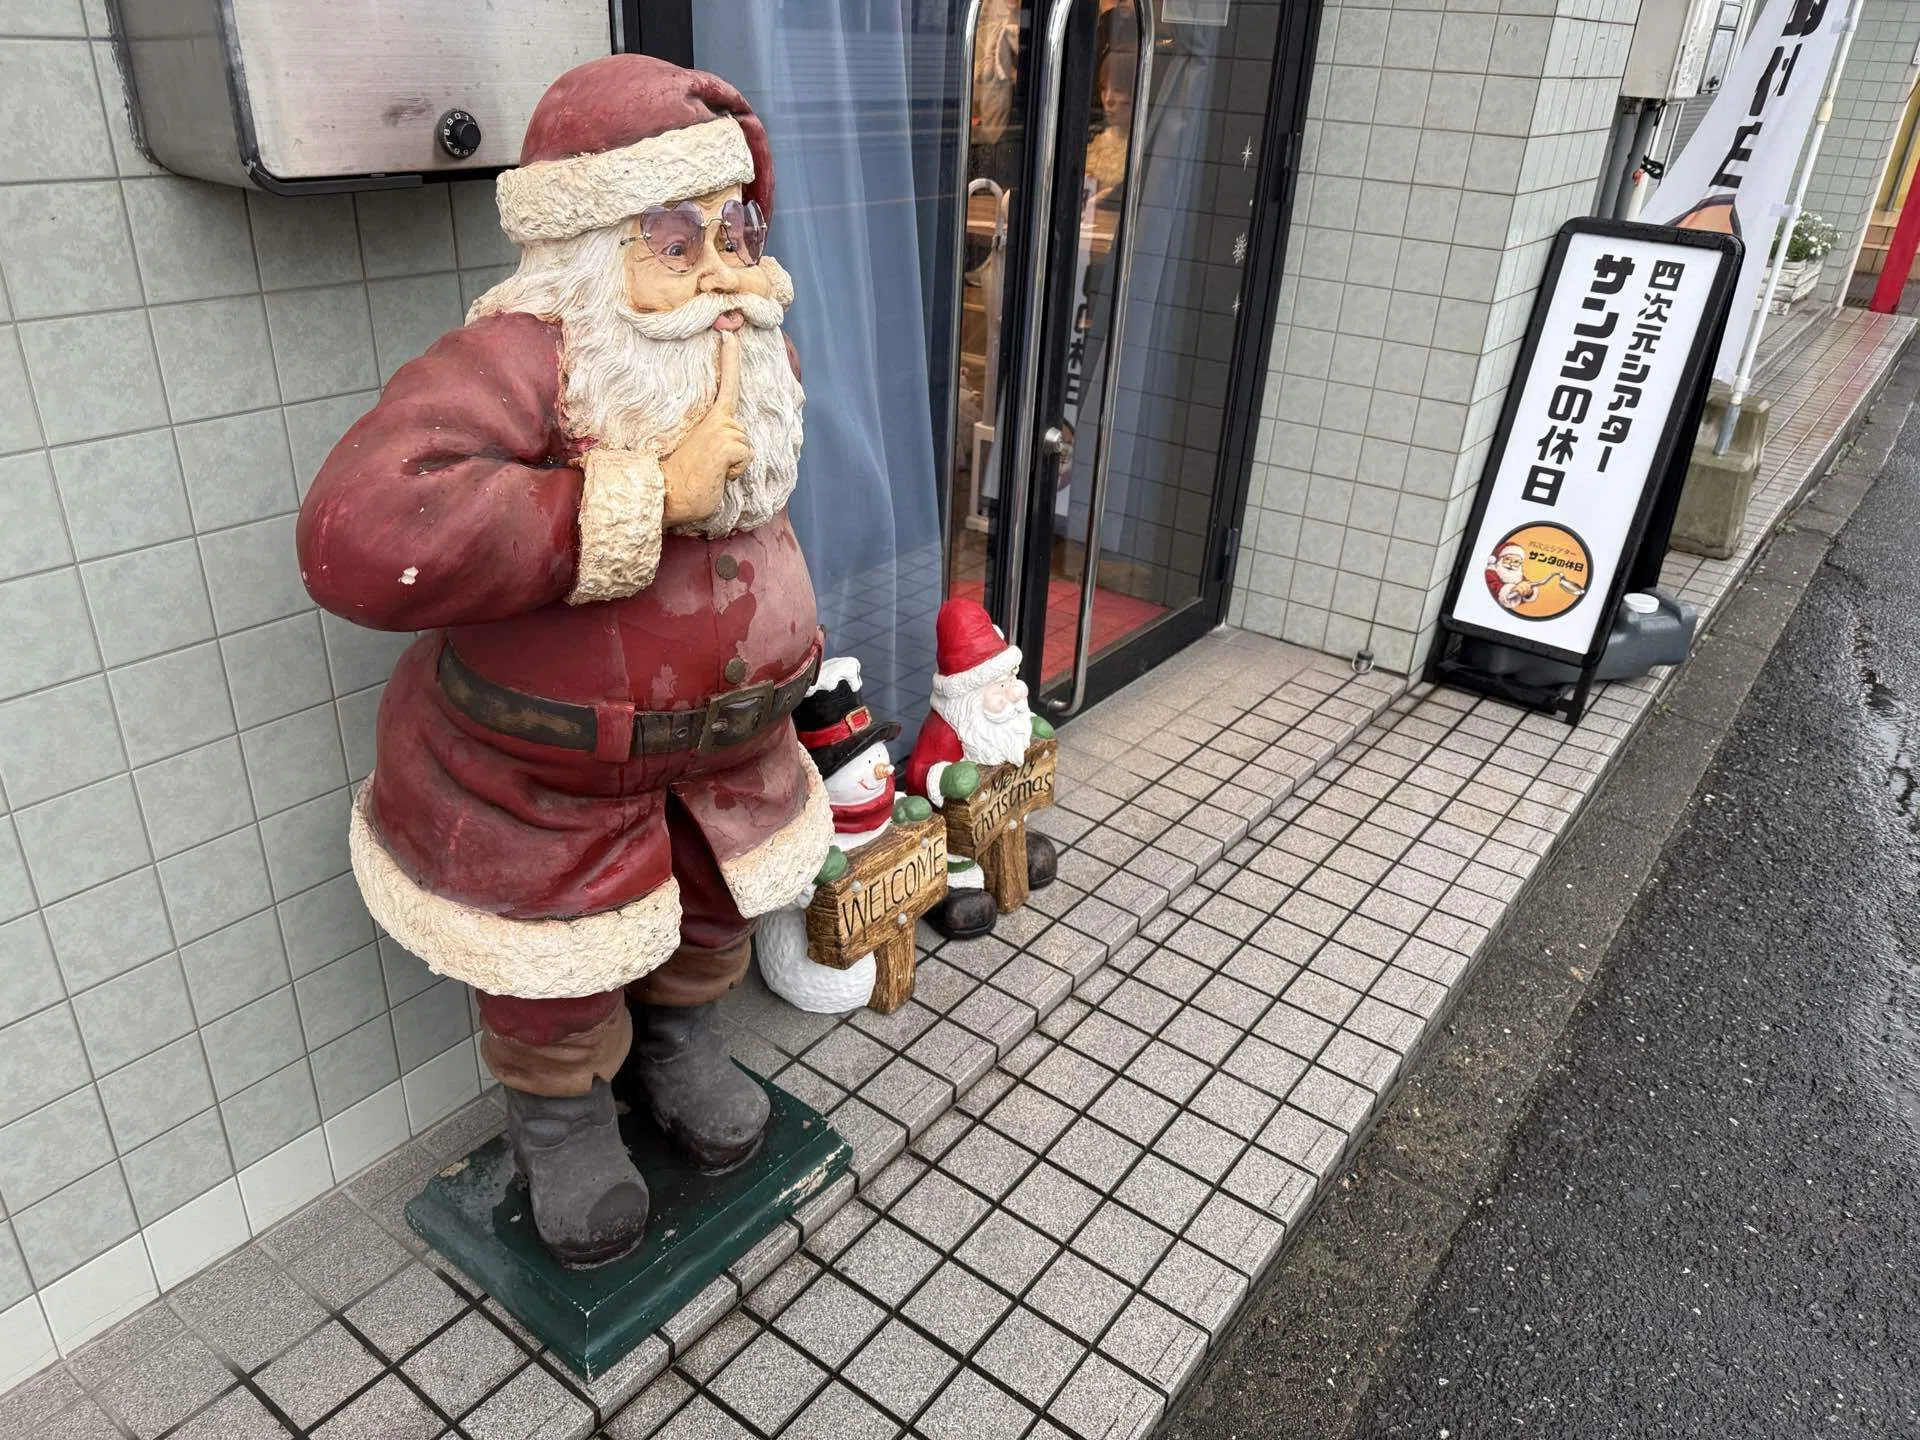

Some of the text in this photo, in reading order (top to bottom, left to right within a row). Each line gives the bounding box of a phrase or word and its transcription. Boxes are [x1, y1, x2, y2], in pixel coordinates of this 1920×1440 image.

[1521, 253, 1635, 507] サンタの休日
[1597, 260, 1685, 472] 四次元シアター
[1528, 551, 1585, 572] サンタの休日
[841, 838, 944, 939] WELCOME
